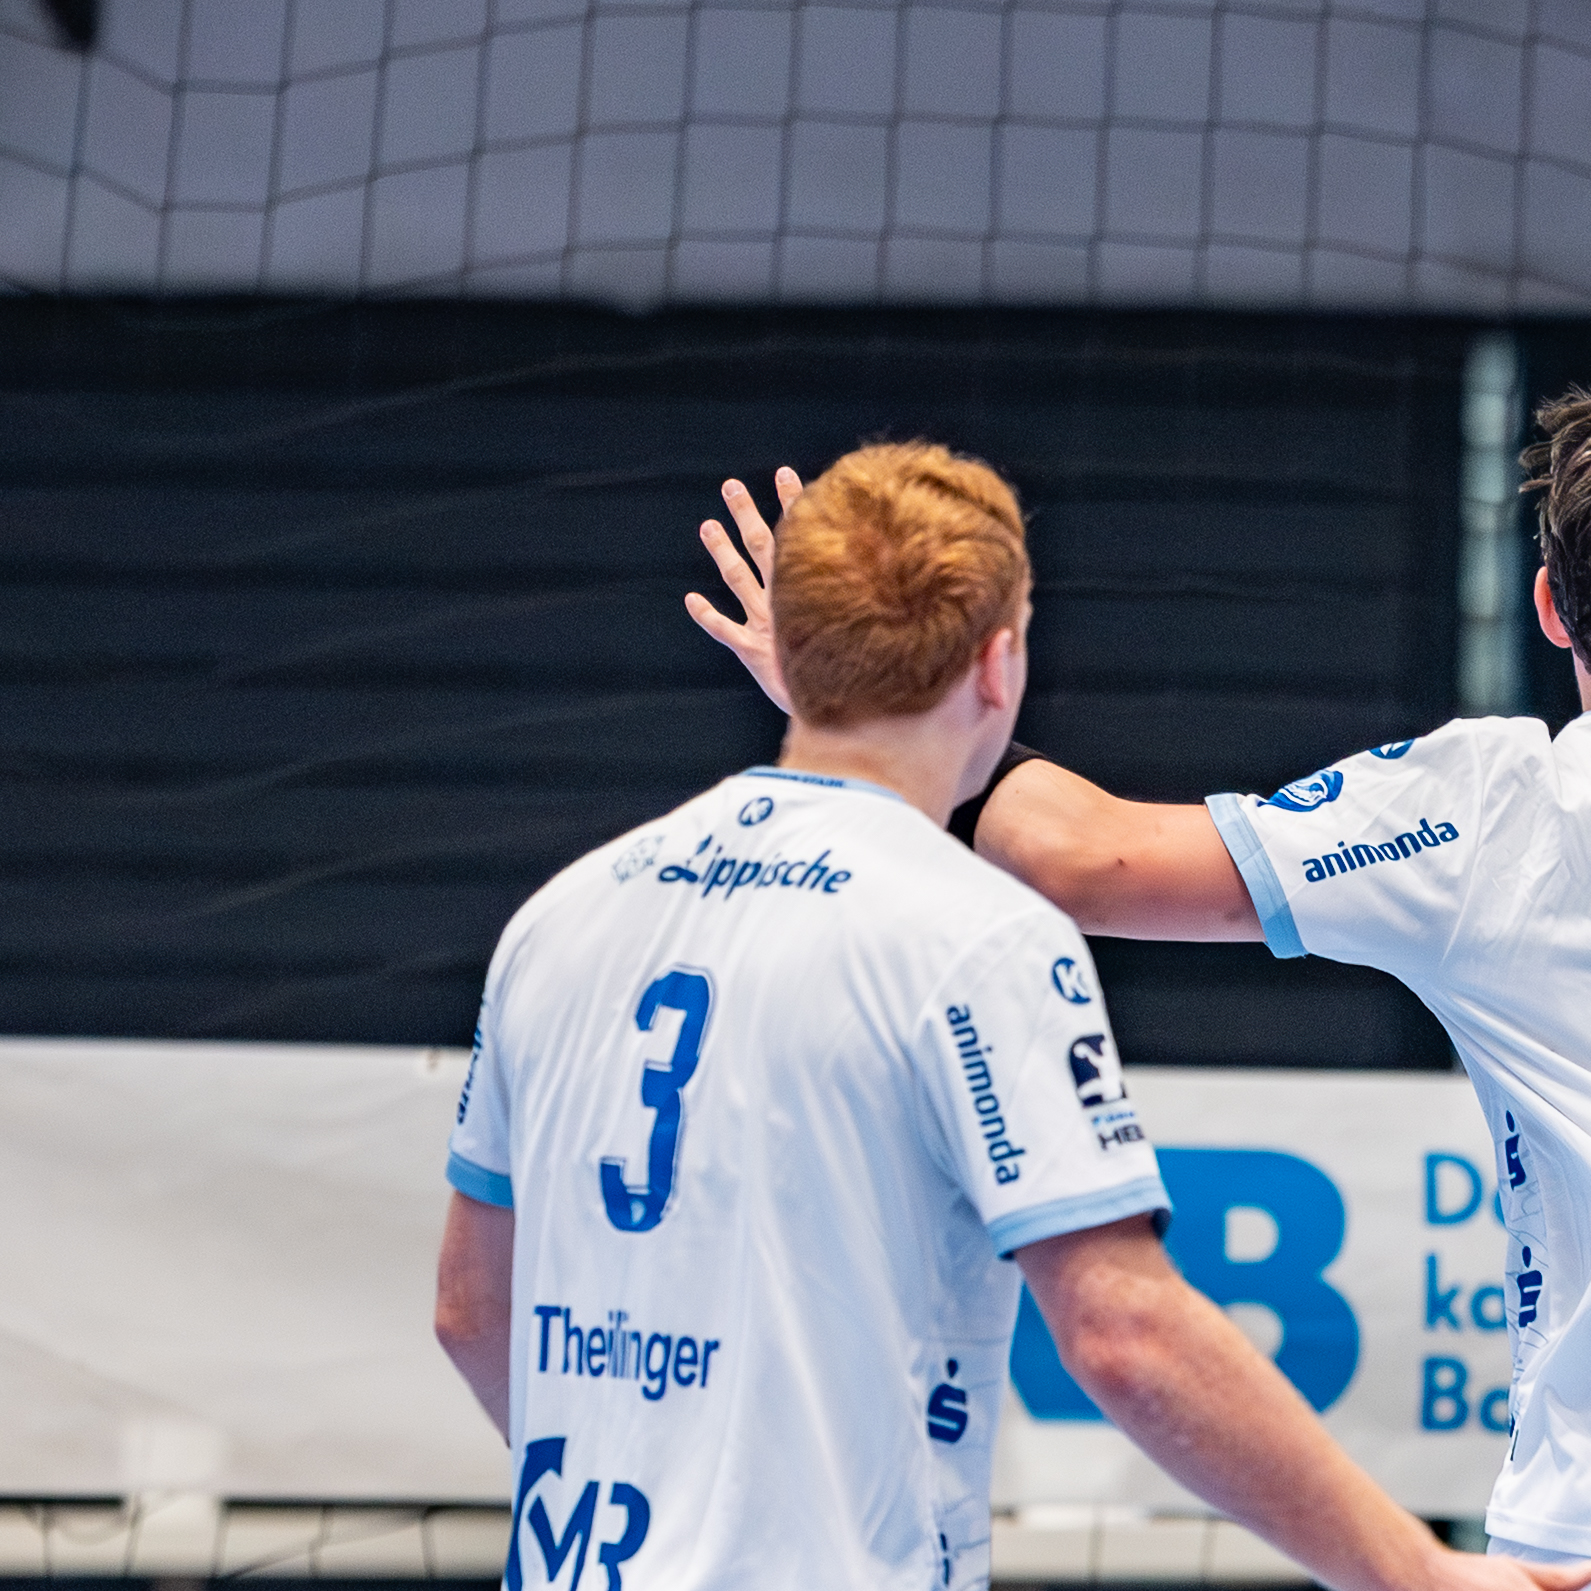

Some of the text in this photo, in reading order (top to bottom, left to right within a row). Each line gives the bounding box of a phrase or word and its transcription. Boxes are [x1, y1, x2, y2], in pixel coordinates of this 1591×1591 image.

[658, 834, 852, 901] Lippische
[1302, 817, 1460, 883] animonda
[600, 963, 715, 1232] 3
[946, 1003, 1026, 1186] animonda
